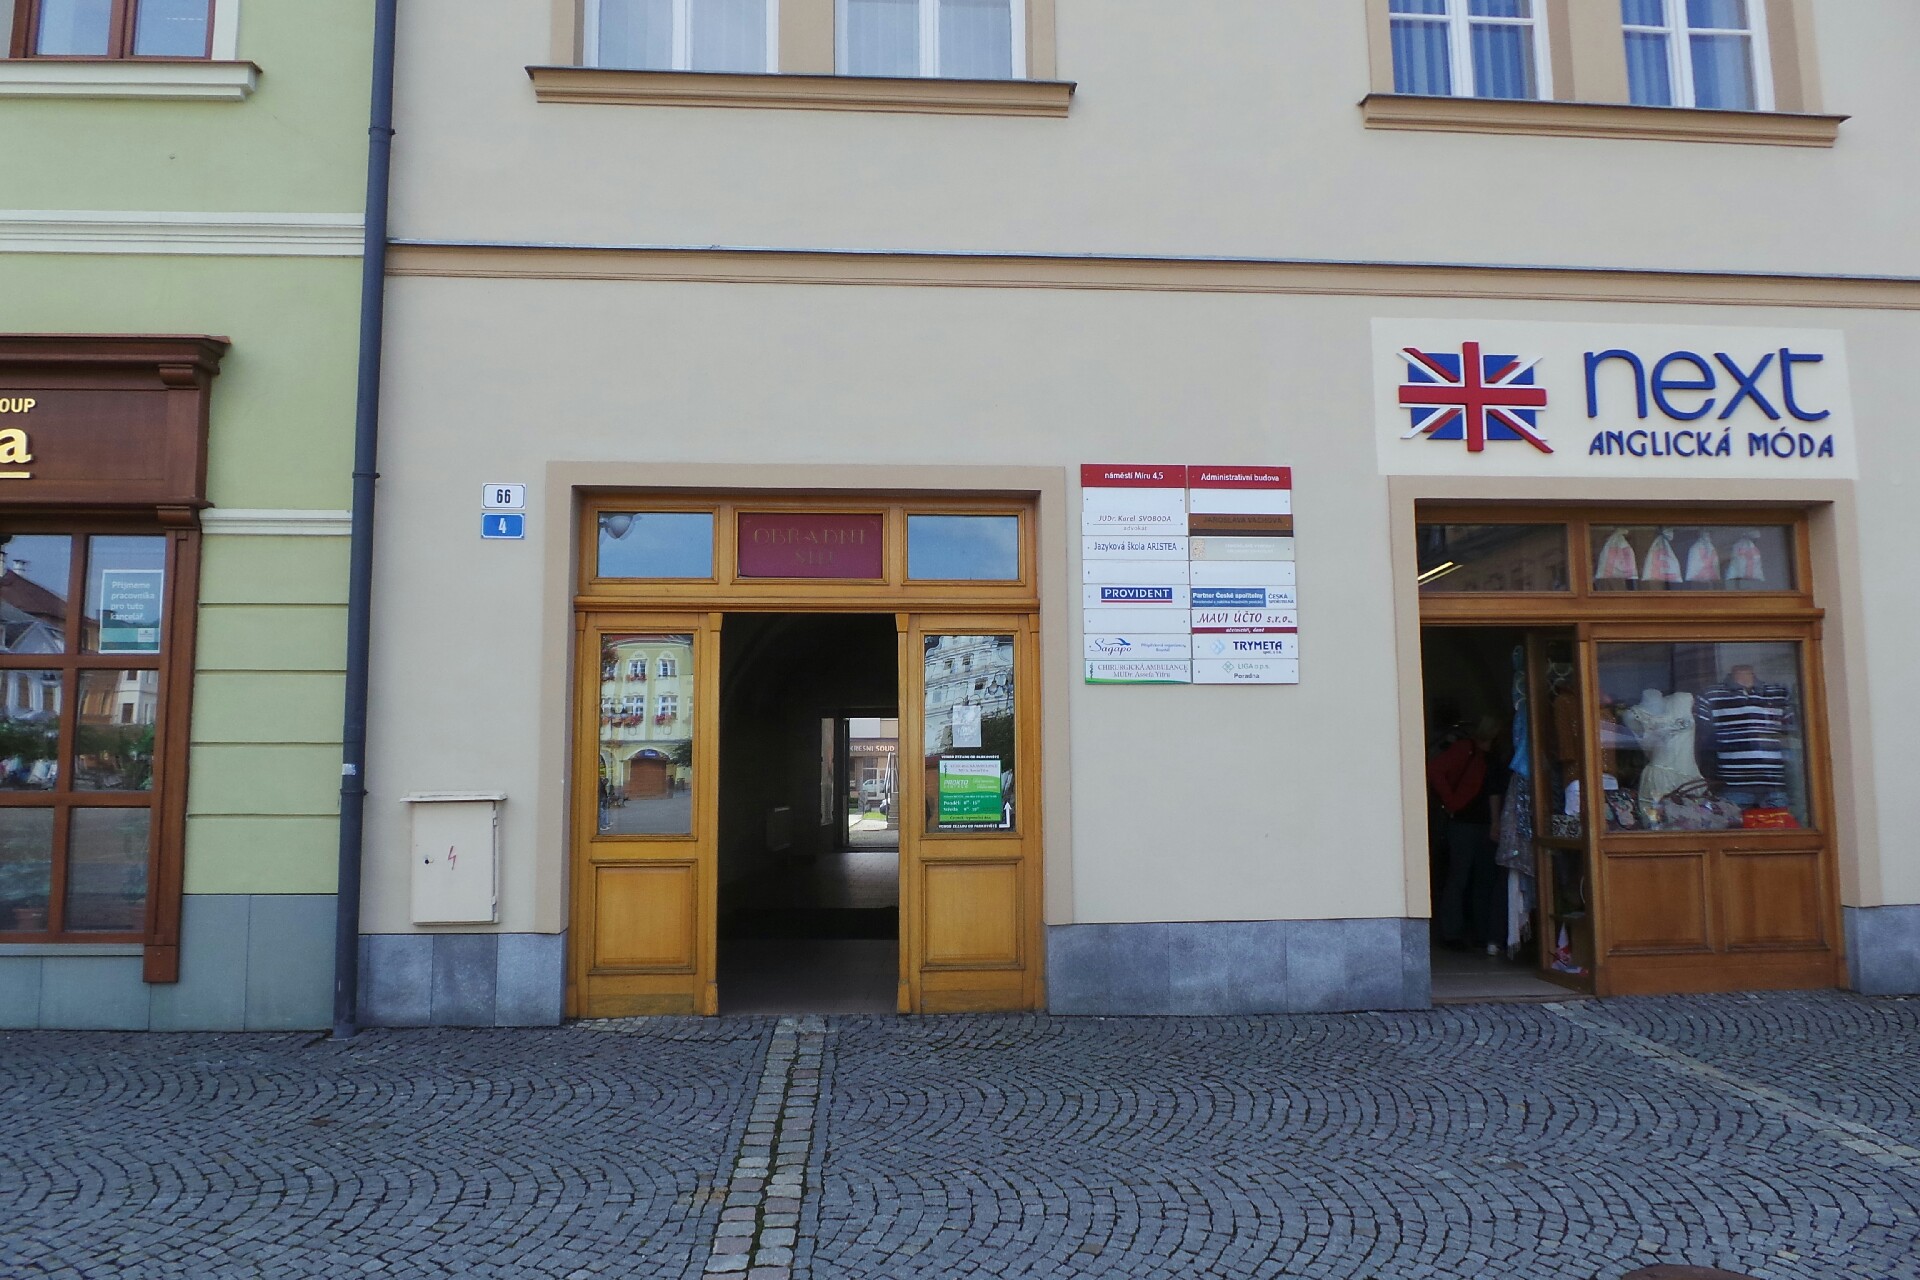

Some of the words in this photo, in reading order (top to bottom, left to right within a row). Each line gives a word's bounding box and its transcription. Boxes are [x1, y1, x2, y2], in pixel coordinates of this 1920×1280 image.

[1583, 347, 1831, 422] next
[1588, 426, 1731, 458] ANGLICKÁ
[1747, 426, 1835, 459] MÓDA
[1253, 473, 1280, 482] budova
[496, 488, 511, 504] 66
[498, 517, 507, 534] 4
[1093, 541, 1125, 552] Jazyková
[1127, 541, 1145, 551] škola
[1147, 542, 1177, 551] ARISTEA
[1104, 588, 1170, 598] PROVIDENT
[110, 603, 124, 611] pro
[1198, 612, 1229, 623] MAVI
[1233, 611, 1262, 623] ÚČTO
[1232, 640, 1283, 651] TRYMETA
[1097, 662, 1144, 671] CHIRURGICKÁ
[1144, 663, 1189, 671] AMBULANCE
